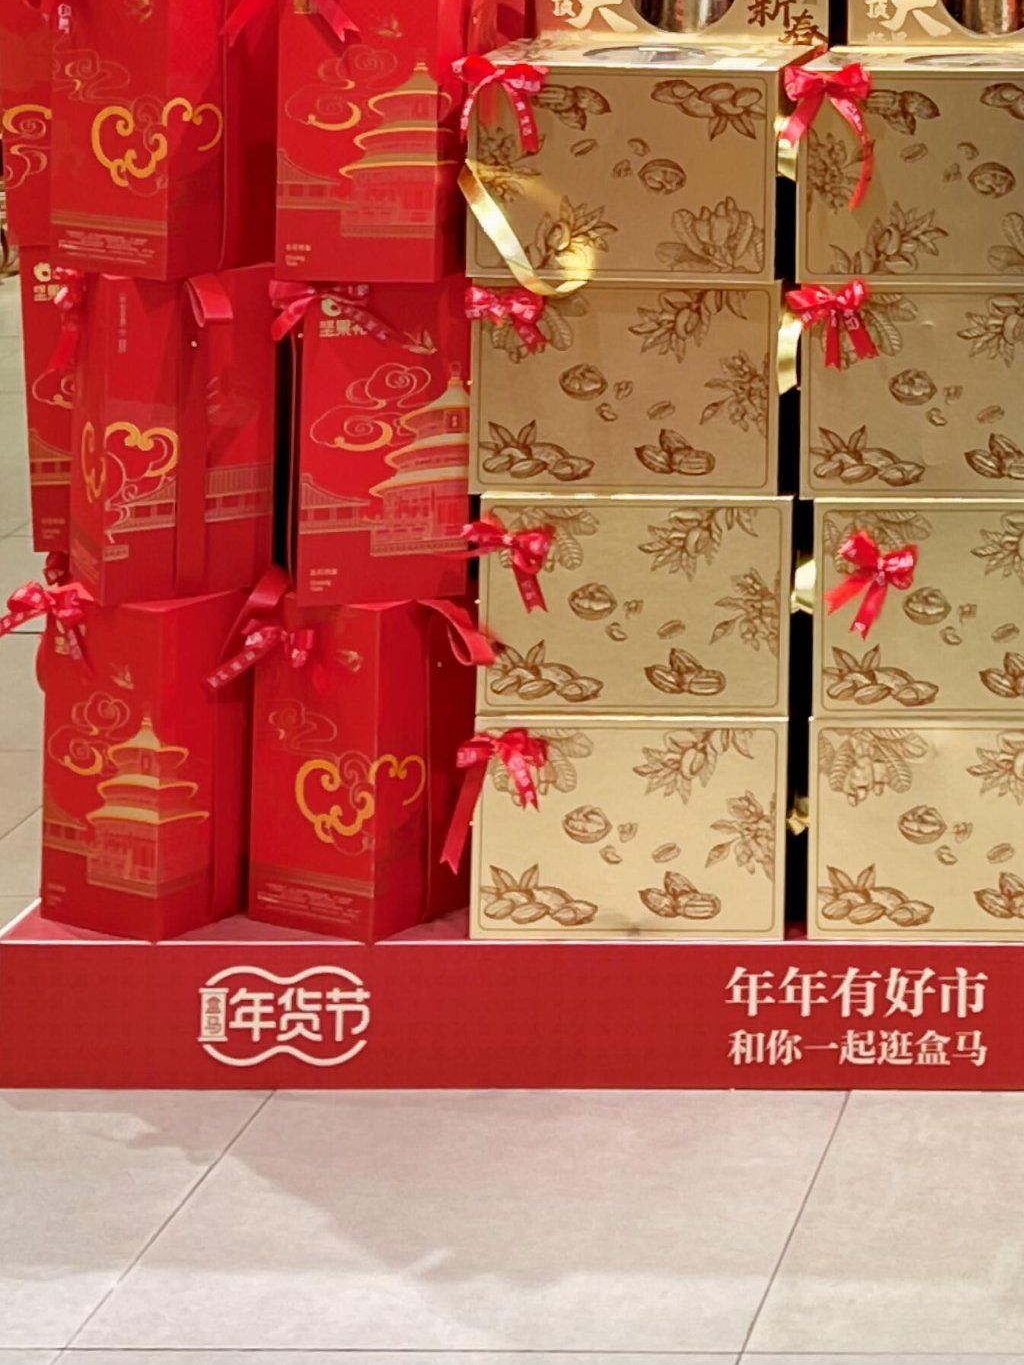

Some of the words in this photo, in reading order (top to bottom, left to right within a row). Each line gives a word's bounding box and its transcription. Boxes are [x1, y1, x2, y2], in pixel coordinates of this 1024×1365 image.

[229, 987, 371, 1042] 年货节
[724, 966, 989, 1019] 年年有好市
[727, 1029, 989, 1067] 和你一起逛盒马
